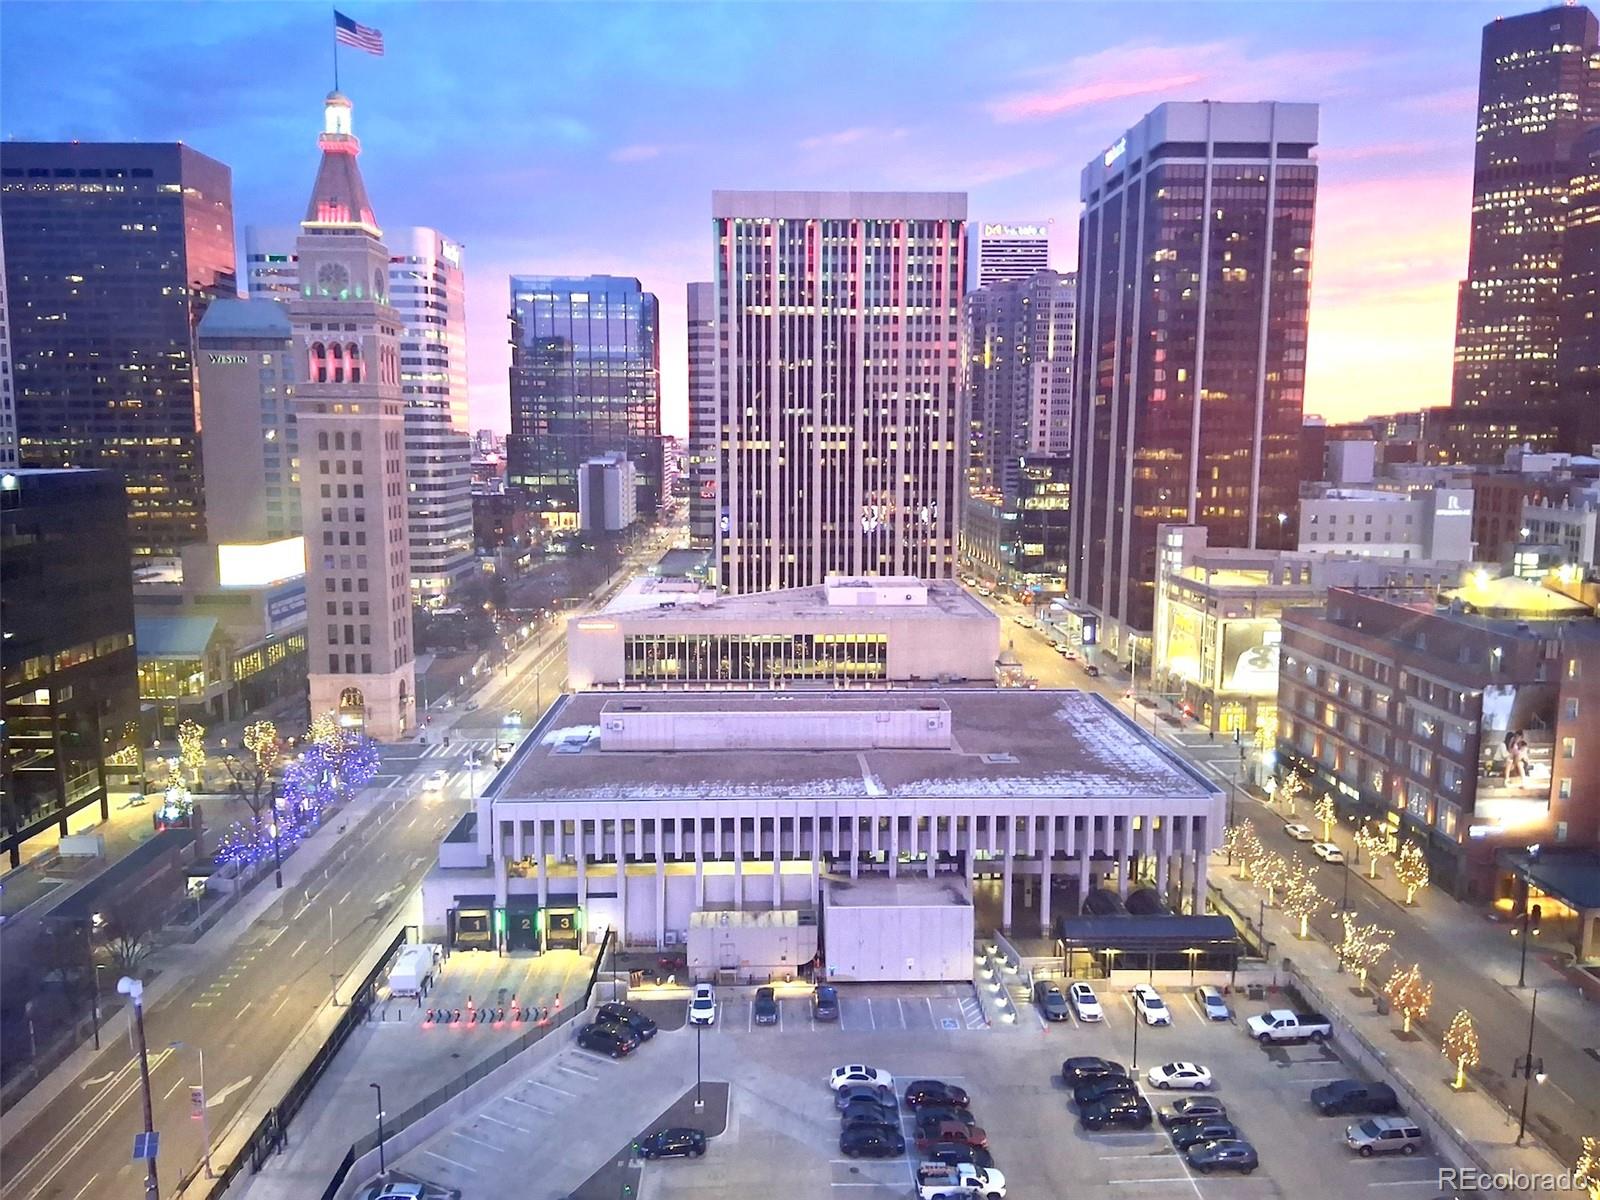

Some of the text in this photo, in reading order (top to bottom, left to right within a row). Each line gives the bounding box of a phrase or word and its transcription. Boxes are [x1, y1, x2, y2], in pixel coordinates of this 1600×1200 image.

[473, 920, 480, 930] 1
[521, 918, 531, 929] 2
[560, 918, 570, 929] 3
